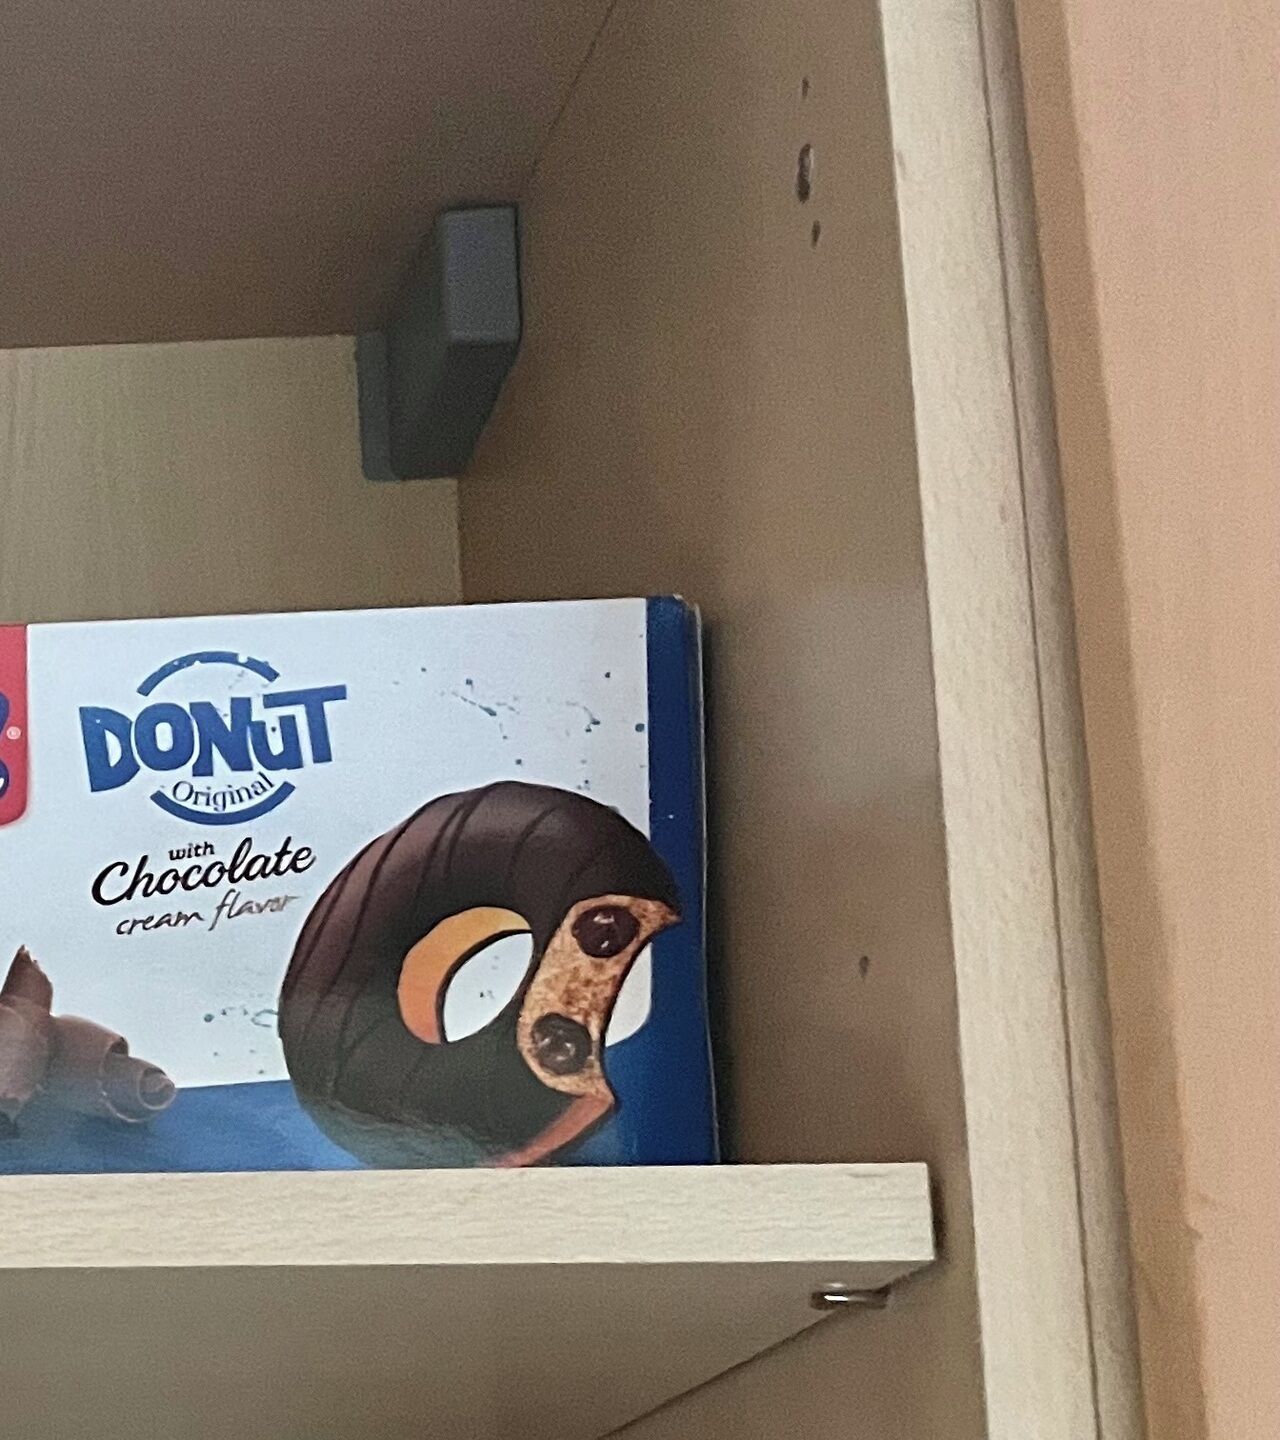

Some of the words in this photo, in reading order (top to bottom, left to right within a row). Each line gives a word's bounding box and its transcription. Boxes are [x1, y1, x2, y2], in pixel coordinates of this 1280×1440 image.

[172, 772, 275, 811] Original
[91, 837, 316, 906] Chocolate
[168, 842, 215, 860] with
[116, 911, 204, 934] cream
[208, 889, 301, 931] flavor
